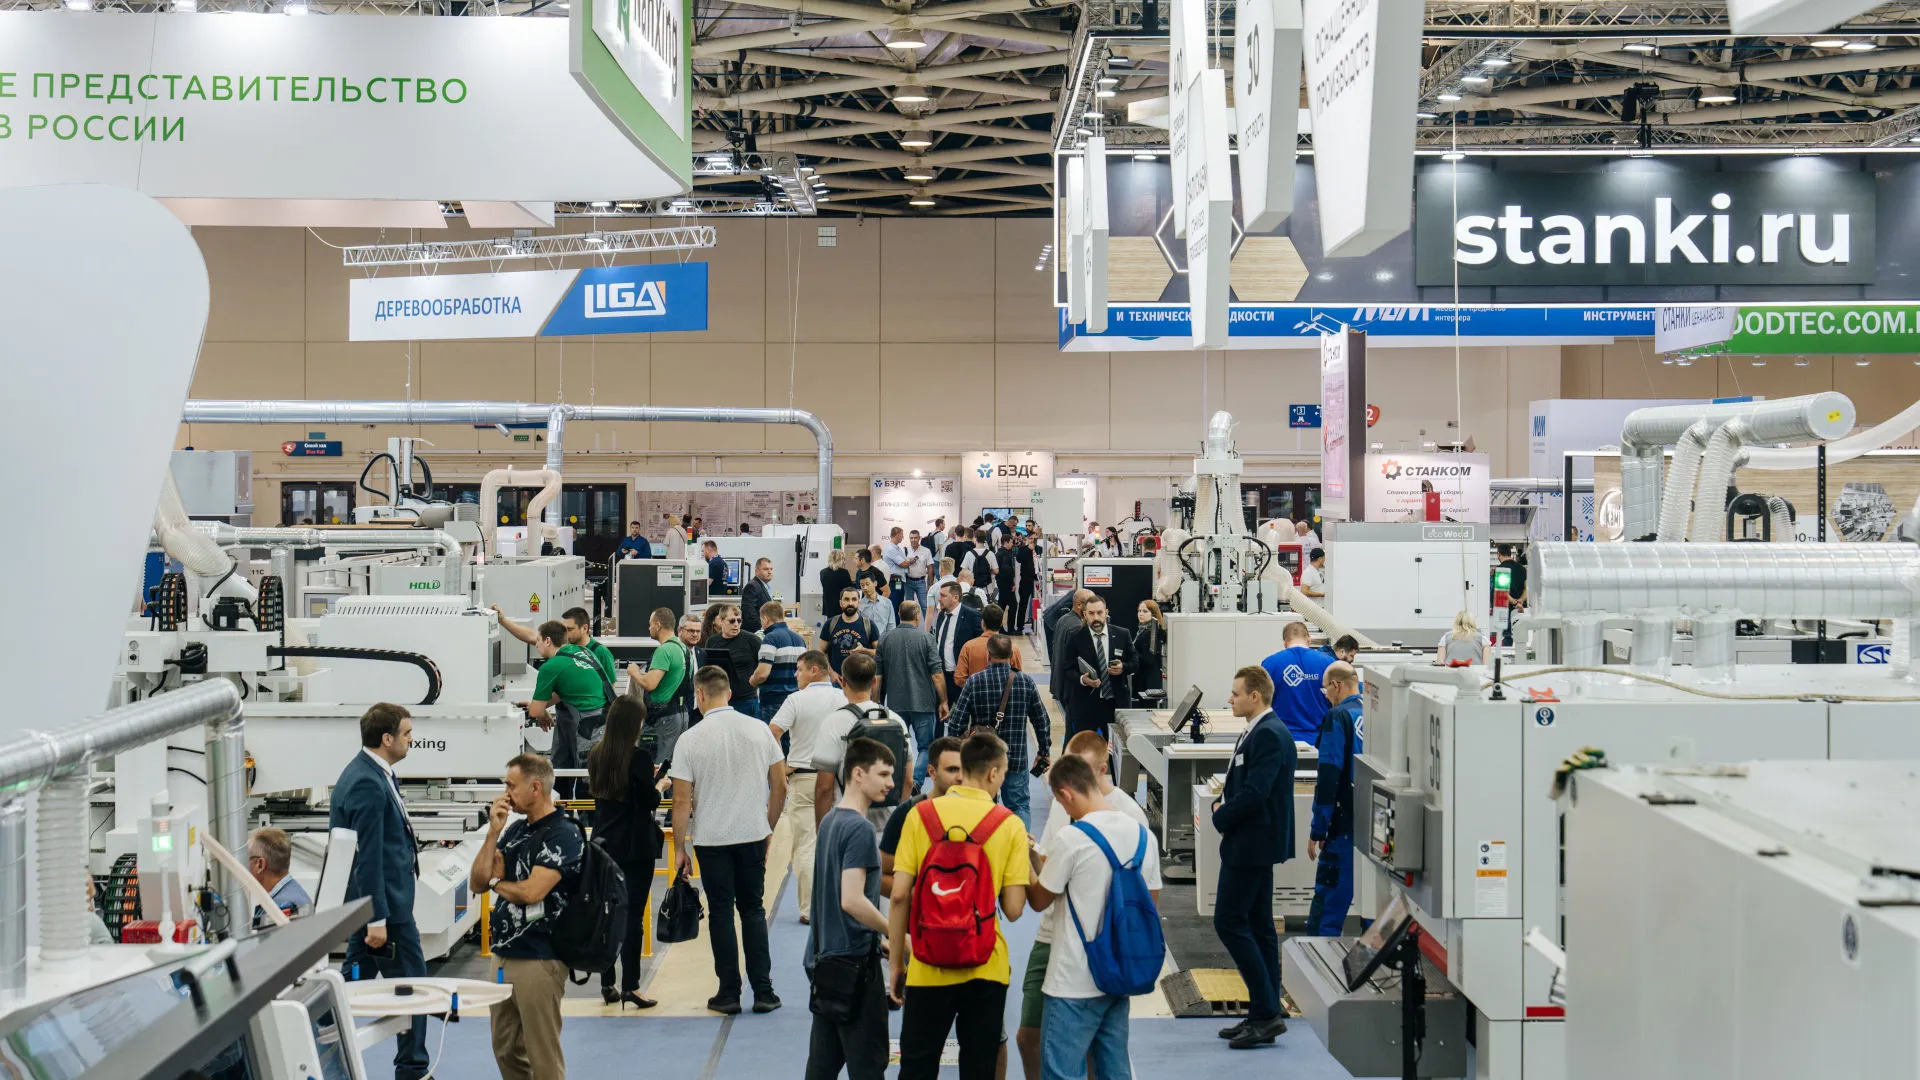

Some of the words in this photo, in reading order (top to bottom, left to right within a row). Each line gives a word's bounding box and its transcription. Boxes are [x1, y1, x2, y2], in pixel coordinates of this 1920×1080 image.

[1247, 23, 1260, 96] 30
[33, 73, 468, 104] ПРЕДСТАВИТЕЛЬСТВО
[28, 114, 184, 142] РОССИИ
[1456, 193, 1850, 264] stanki.ru
[375, 296, 522, 321] ДЕРЕВООБРАБОТКА
[584, 281, 666, 318] LIGA
[1116, 311, 1124, 321] И
[1129, 311, 1191, 321] ТЕХНИЧЕСК
[1229, 311, 1274, 323] ДКОСТИ
[1367, 409, 1374, 420] 2
[1405, 466, 1471, 476] СТАНКОМ
